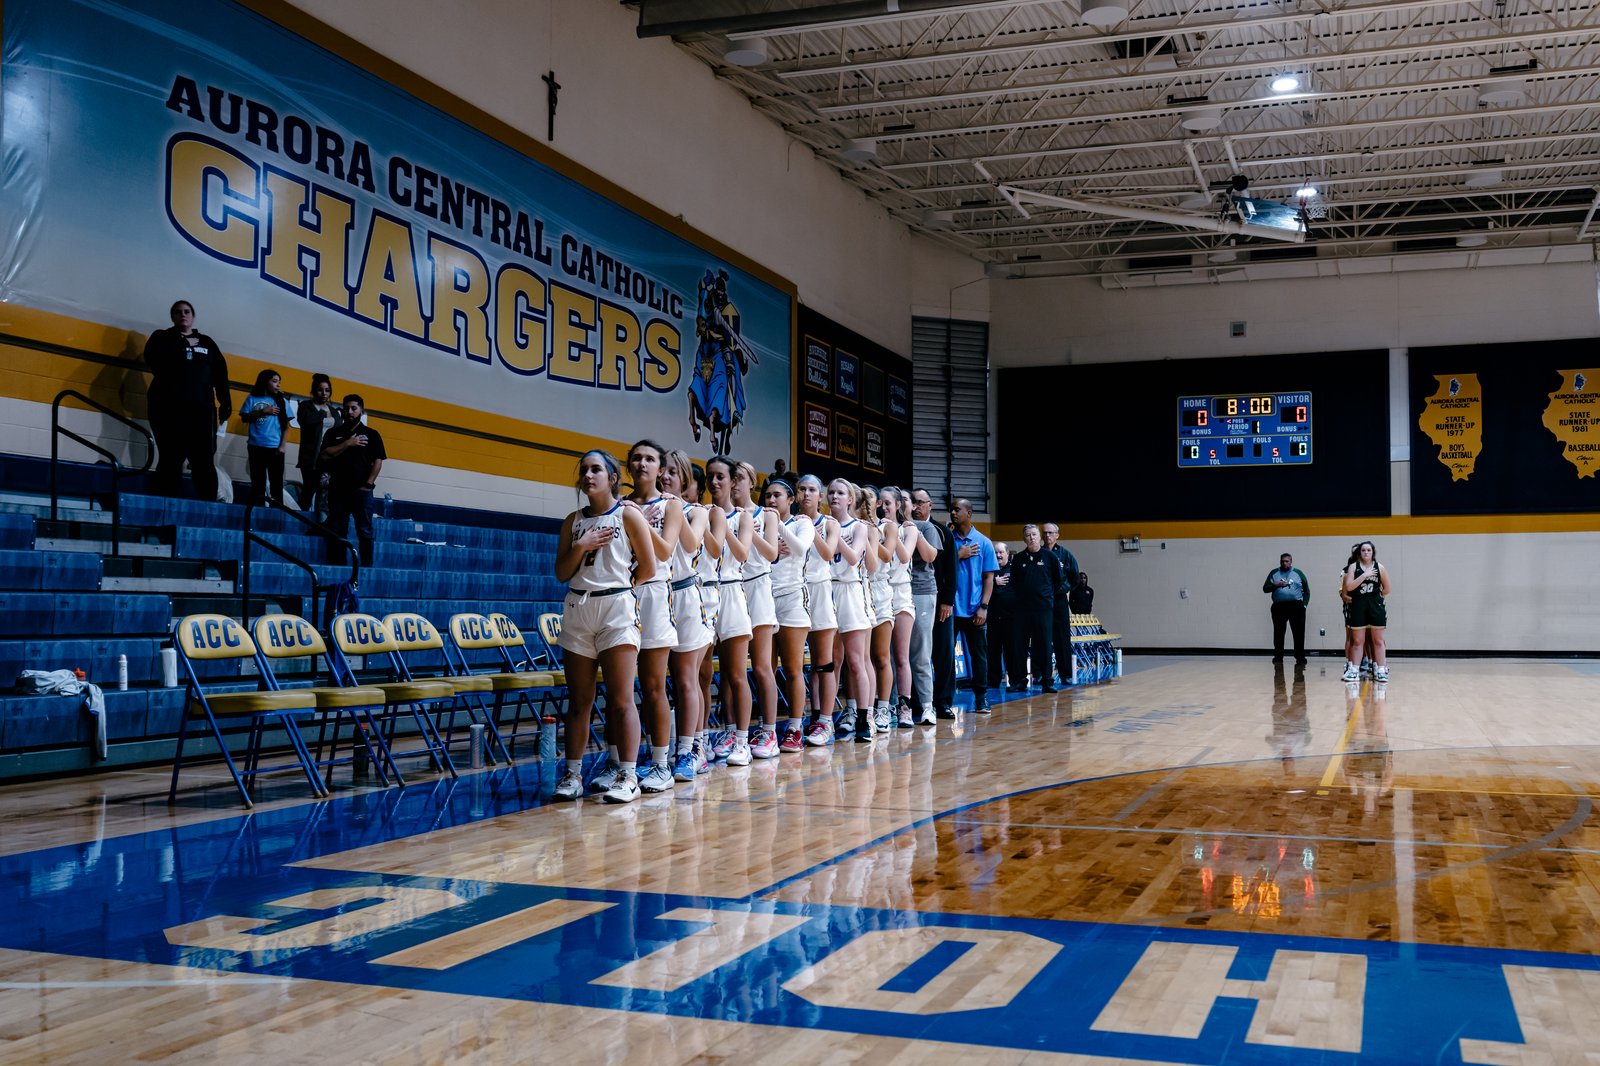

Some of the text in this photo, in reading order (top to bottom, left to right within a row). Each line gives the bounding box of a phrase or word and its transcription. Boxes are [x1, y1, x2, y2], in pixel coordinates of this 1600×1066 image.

[166, 75, 683, 319] AURORA CENTRAL CATHOLIC
[165, 132, 682, 393] CHARGERS
[1184, 399, 1206, 407] HOME
[1227, 398, 1271, 415] 8:00
[1278, 395, 1310, 404] VISITOR
[1198, 410, 1208, 426] 0
[1296, 406, 1307, 422] 0
[1436, 422, 1475, 430] RUNNER-UP
[809, 433, 827, 454] Trojans
[1191, 446, 1199, 459] 0
[1299, 443, 1307, 456] 0
[1360, 582, 1374, 594] 30
[190, 619, 241, 649] ACC
[267, 619, 313, 647] ACC
[343, 618, 386, 645] ACC
[392, 618, 431, 642] ACC
[460, 617, 493, 640] ACC
[546, 617, 562, 638] AC
